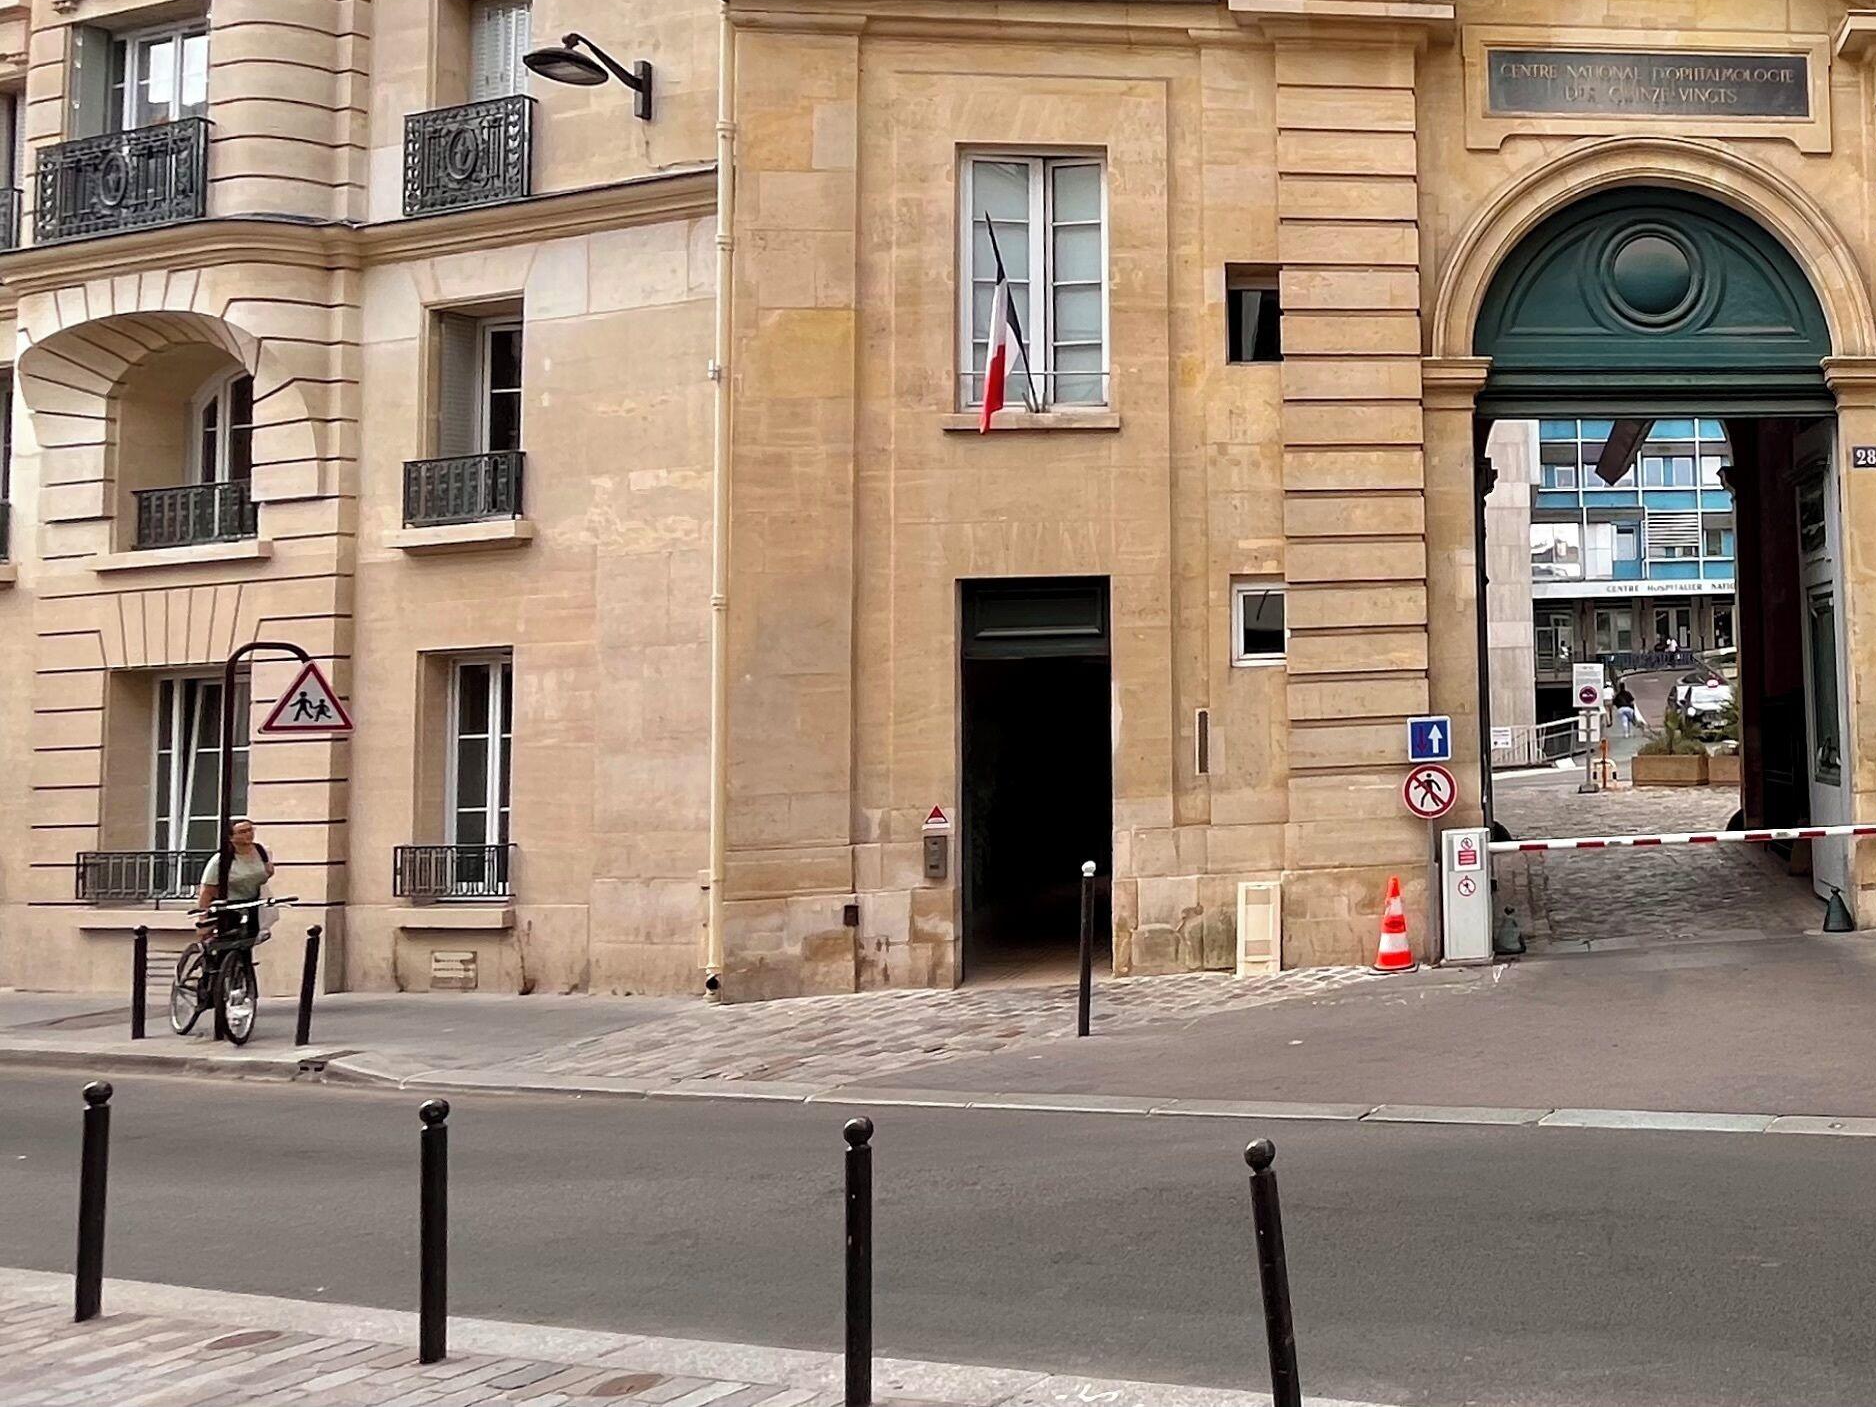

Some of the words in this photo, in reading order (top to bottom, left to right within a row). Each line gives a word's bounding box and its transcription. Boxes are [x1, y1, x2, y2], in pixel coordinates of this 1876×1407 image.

[1500, 64, 1557, 79] CENTRE
[1566, 65, 1639, 80] NATIONAL
[1679, 87, 1738, 104] VINGTS
[1856, 448, 1876, 465] 28
[1606, 584, 1639, 593] CENTRE
[1647, 583, 1703, 592] HOSPITALIER
